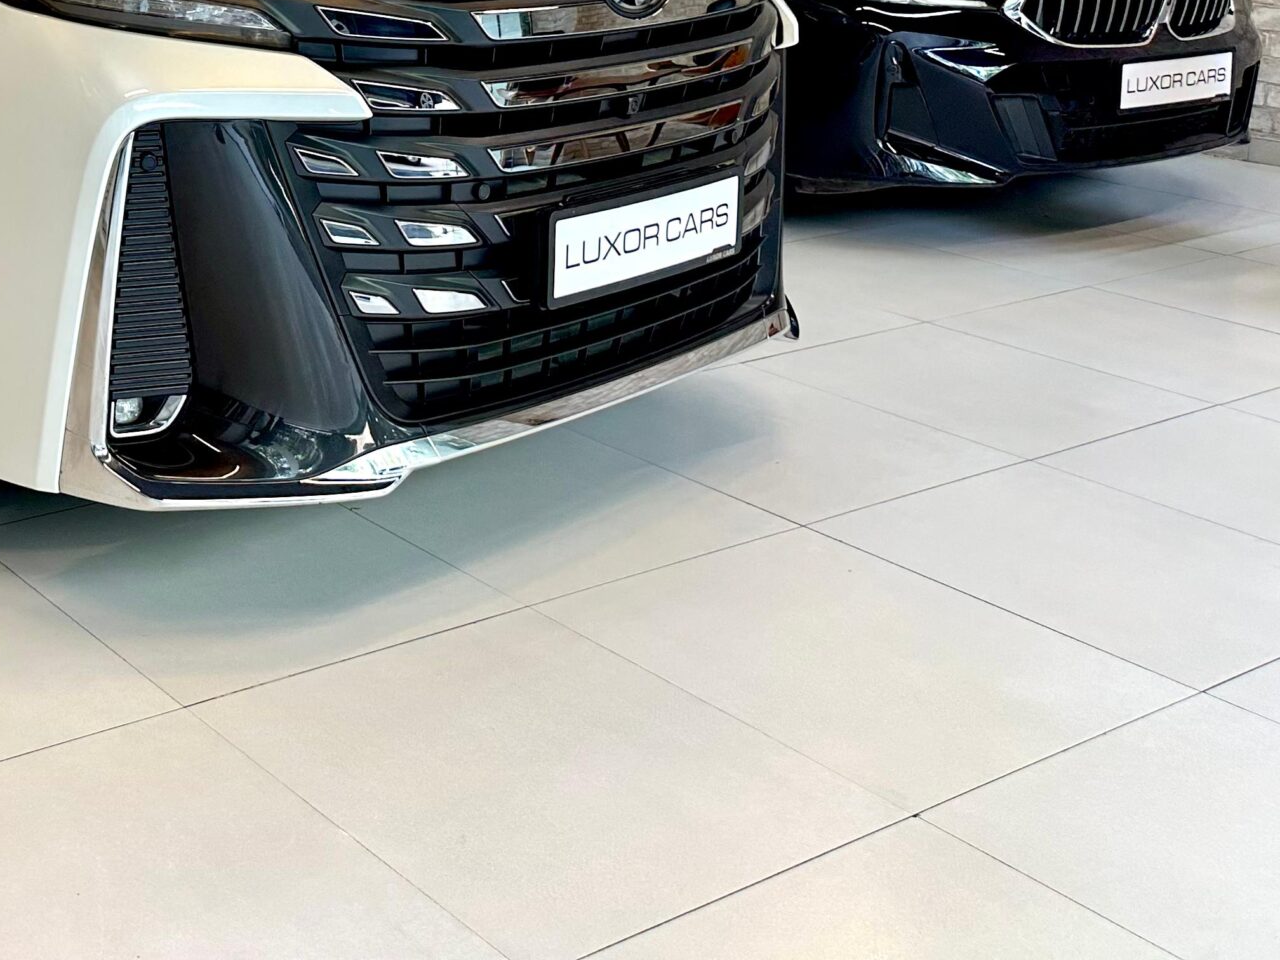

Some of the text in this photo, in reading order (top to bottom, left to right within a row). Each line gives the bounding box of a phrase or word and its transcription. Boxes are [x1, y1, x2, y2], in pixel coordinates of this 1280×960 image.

[1126, 67, 1227, 94] LUXOR CARS
[565, 203, 729, 269] LUXOR CARS
